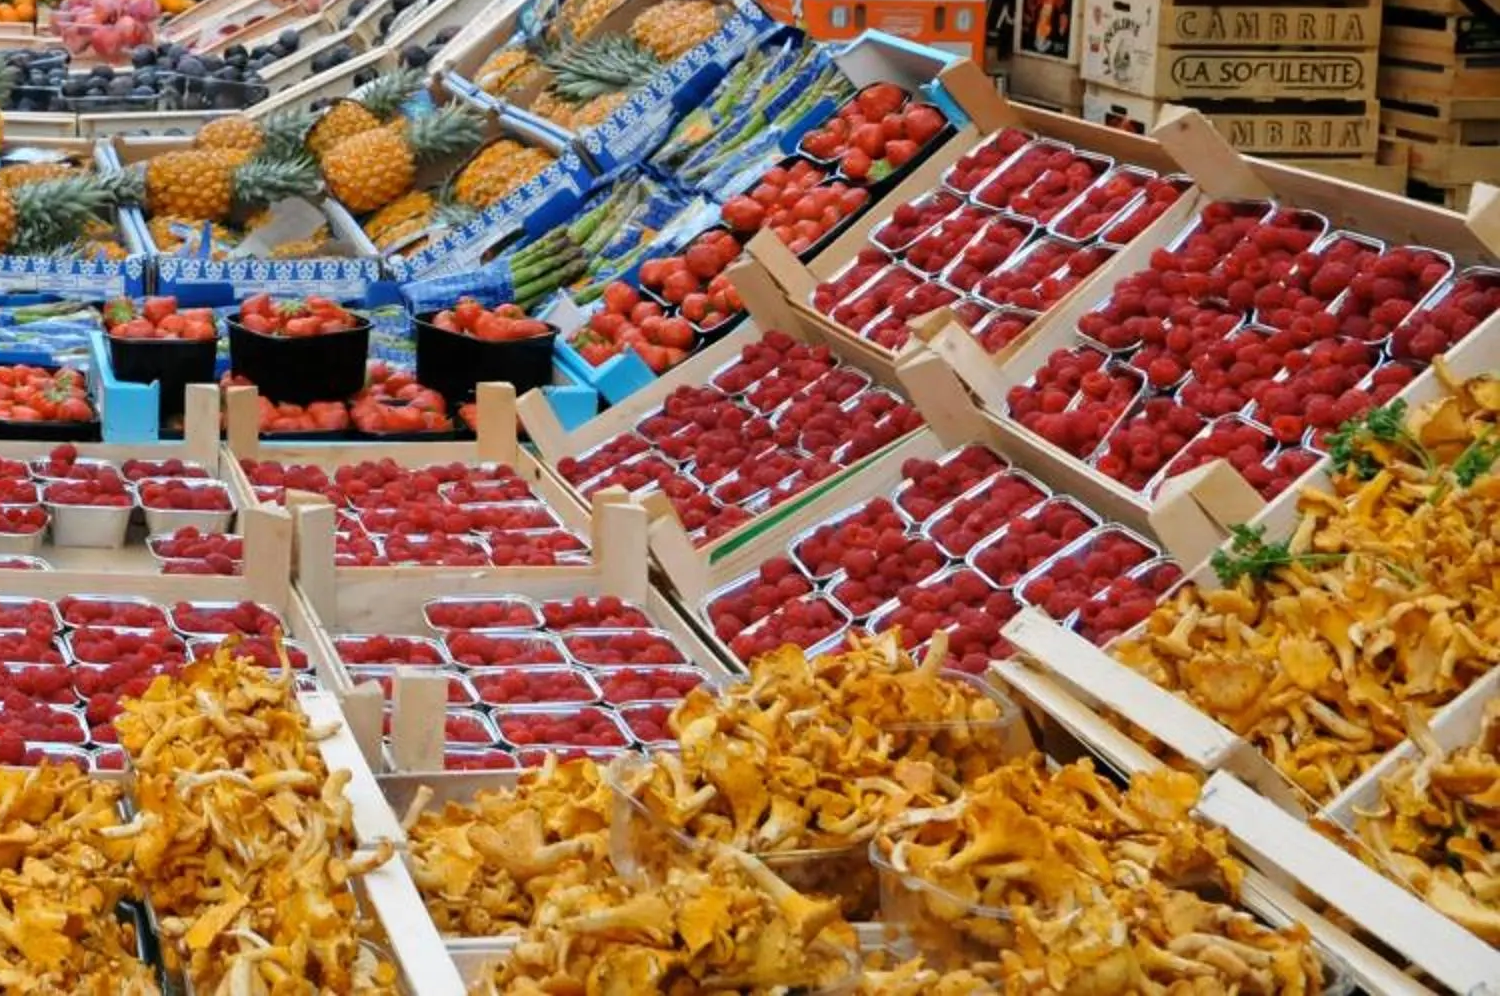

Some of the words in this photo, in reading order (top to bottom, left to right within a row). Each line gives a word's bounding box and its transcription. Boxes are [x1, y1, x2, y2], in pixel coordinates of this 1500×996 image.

[1176, 10, 1365, 40] CAMBRIA
[1180, 61, 1211, 83] LA
[1219, 61, 1354, 84] SOCULENTE
[1228, 119, 1365, 148] MBRIA
